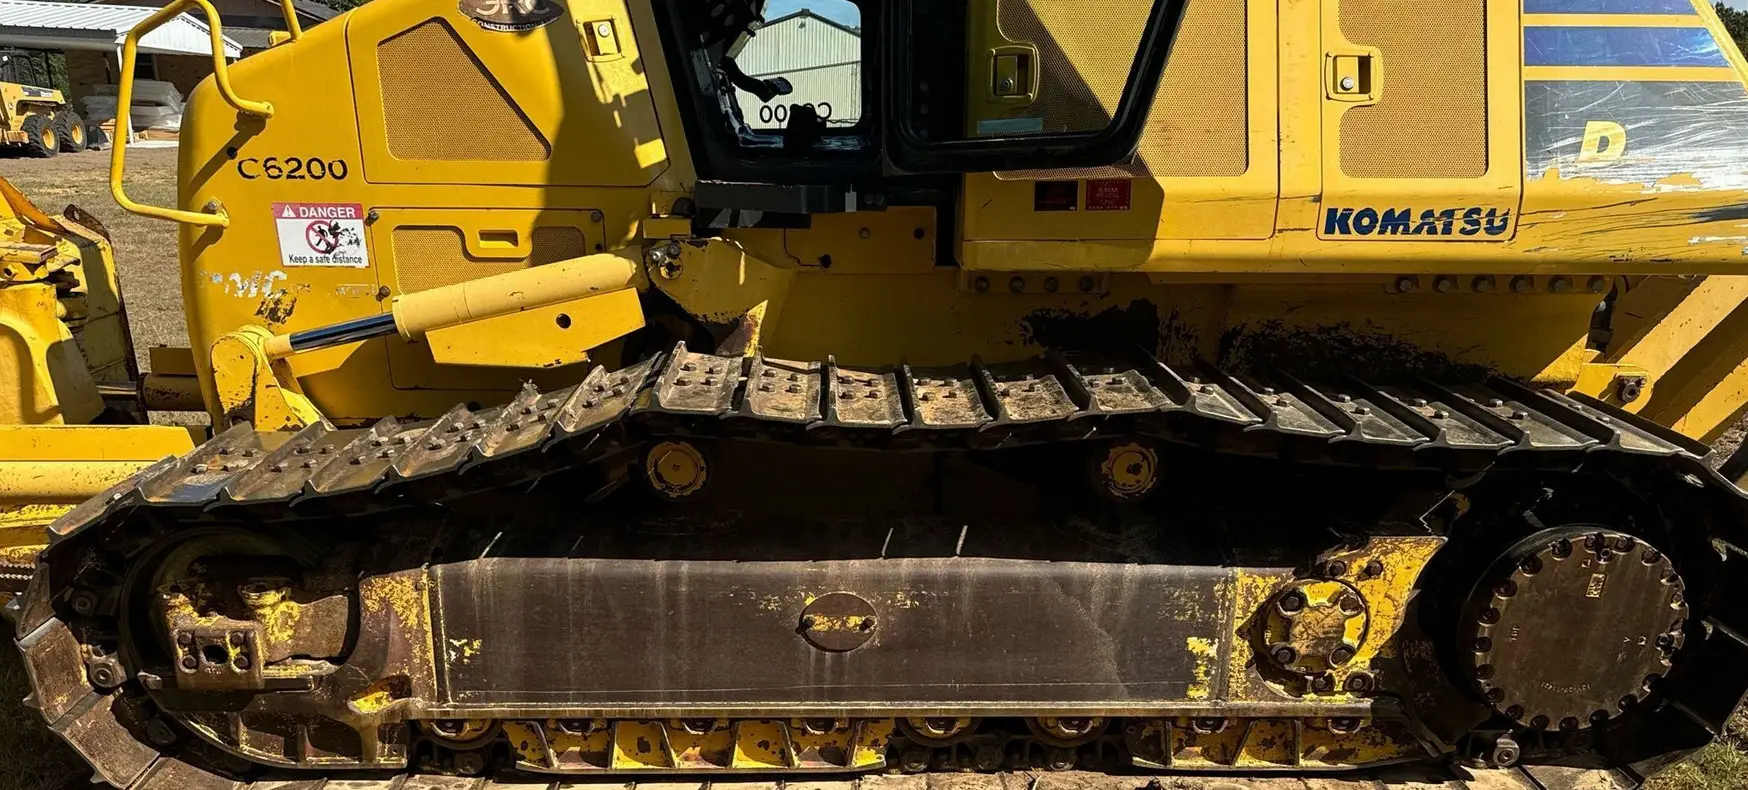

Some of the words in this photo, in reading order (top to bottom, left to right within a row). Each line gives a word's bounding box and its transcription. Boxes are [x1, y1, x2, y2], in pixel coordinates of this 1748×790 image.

[1578, 121, 1627, 164] D
[237, 156, 348, 180] C6200
[299, 206, 356, 218] DANGER
[1324, 207, 1511, 236] KOMATSU
[288, 254, 308, 265] Keep
[315, 254, 331, 264] safe
[332, 253, 363, 264] distance
